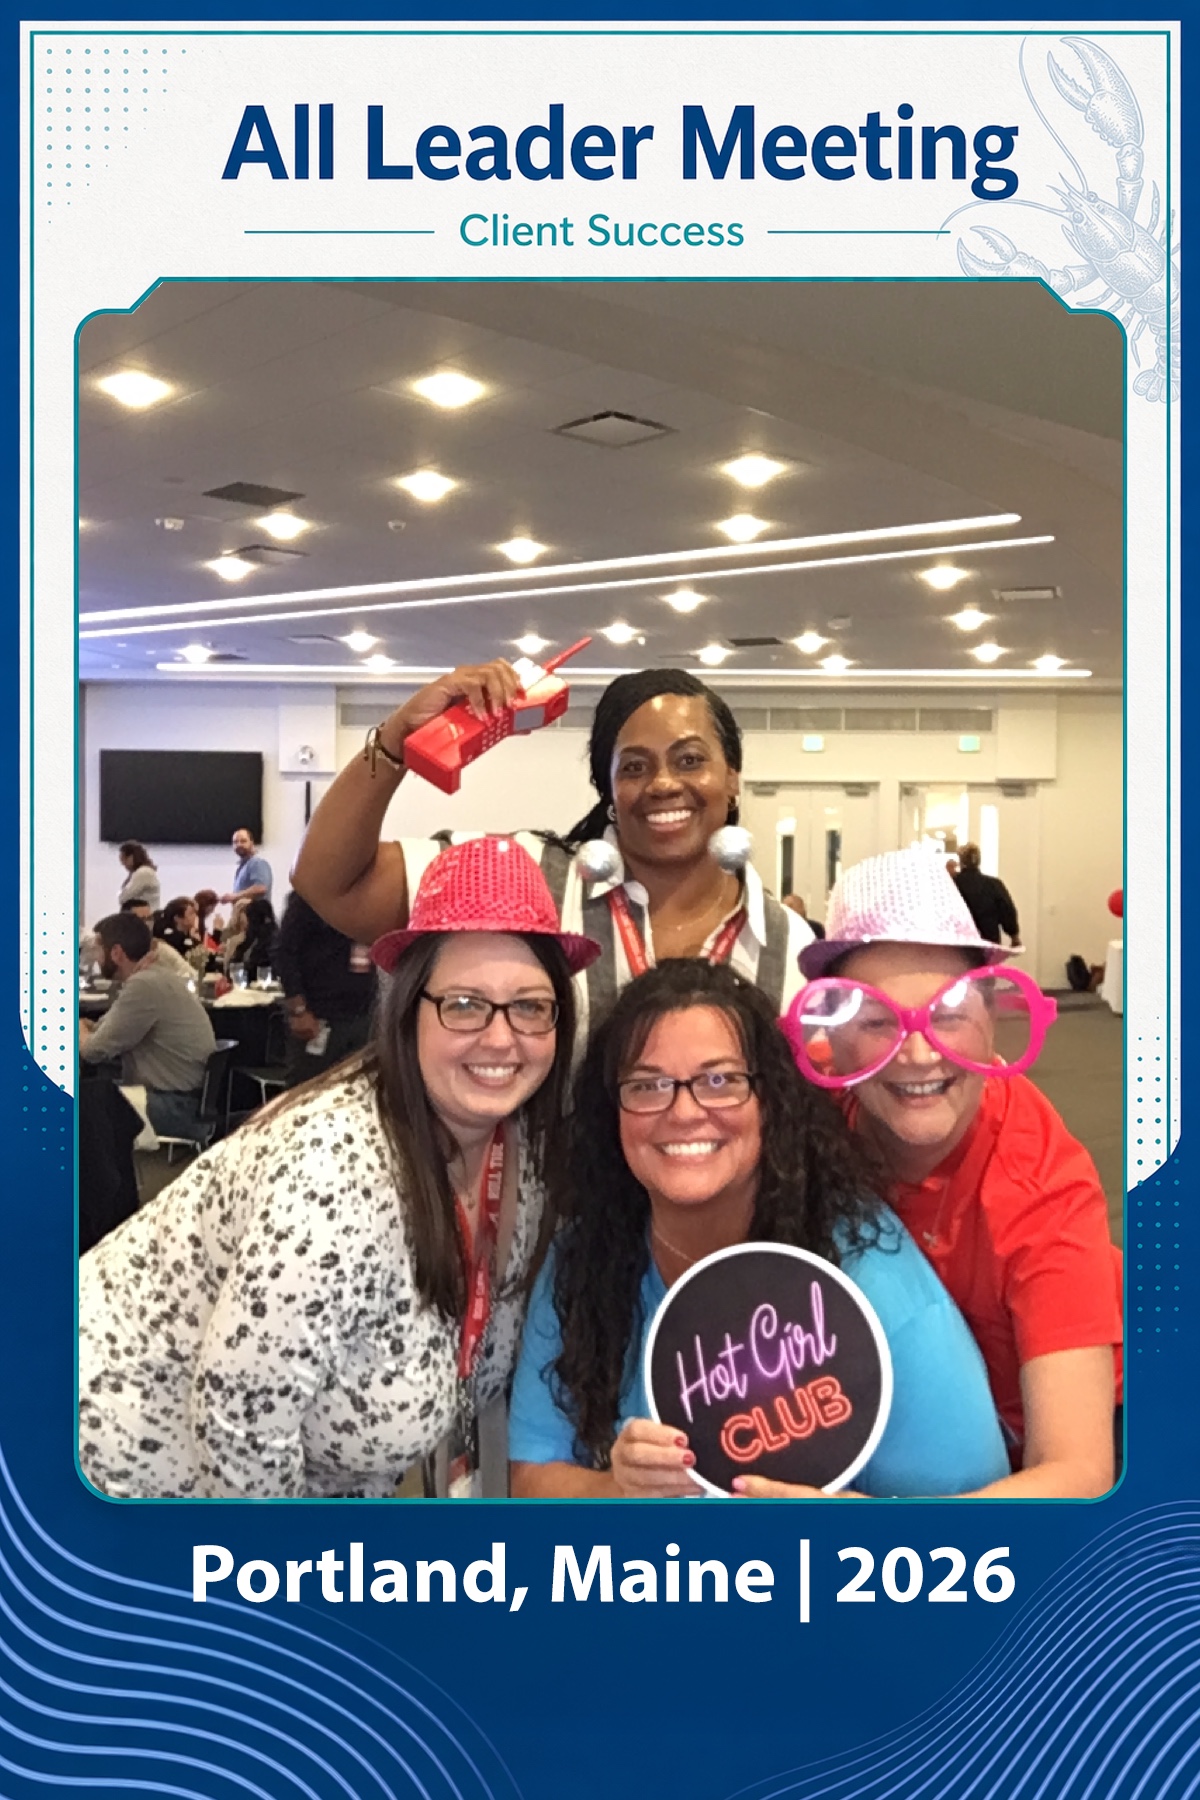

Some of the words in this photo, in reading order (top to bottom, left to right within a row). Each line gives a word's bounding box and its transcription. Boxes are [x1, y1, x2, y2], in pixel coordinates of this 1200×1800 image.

[676, 1333, 748, 1423] Hot
[751, 1280, 837, 1390] Girl
[720, 1376, 853, 1463] CLUB
